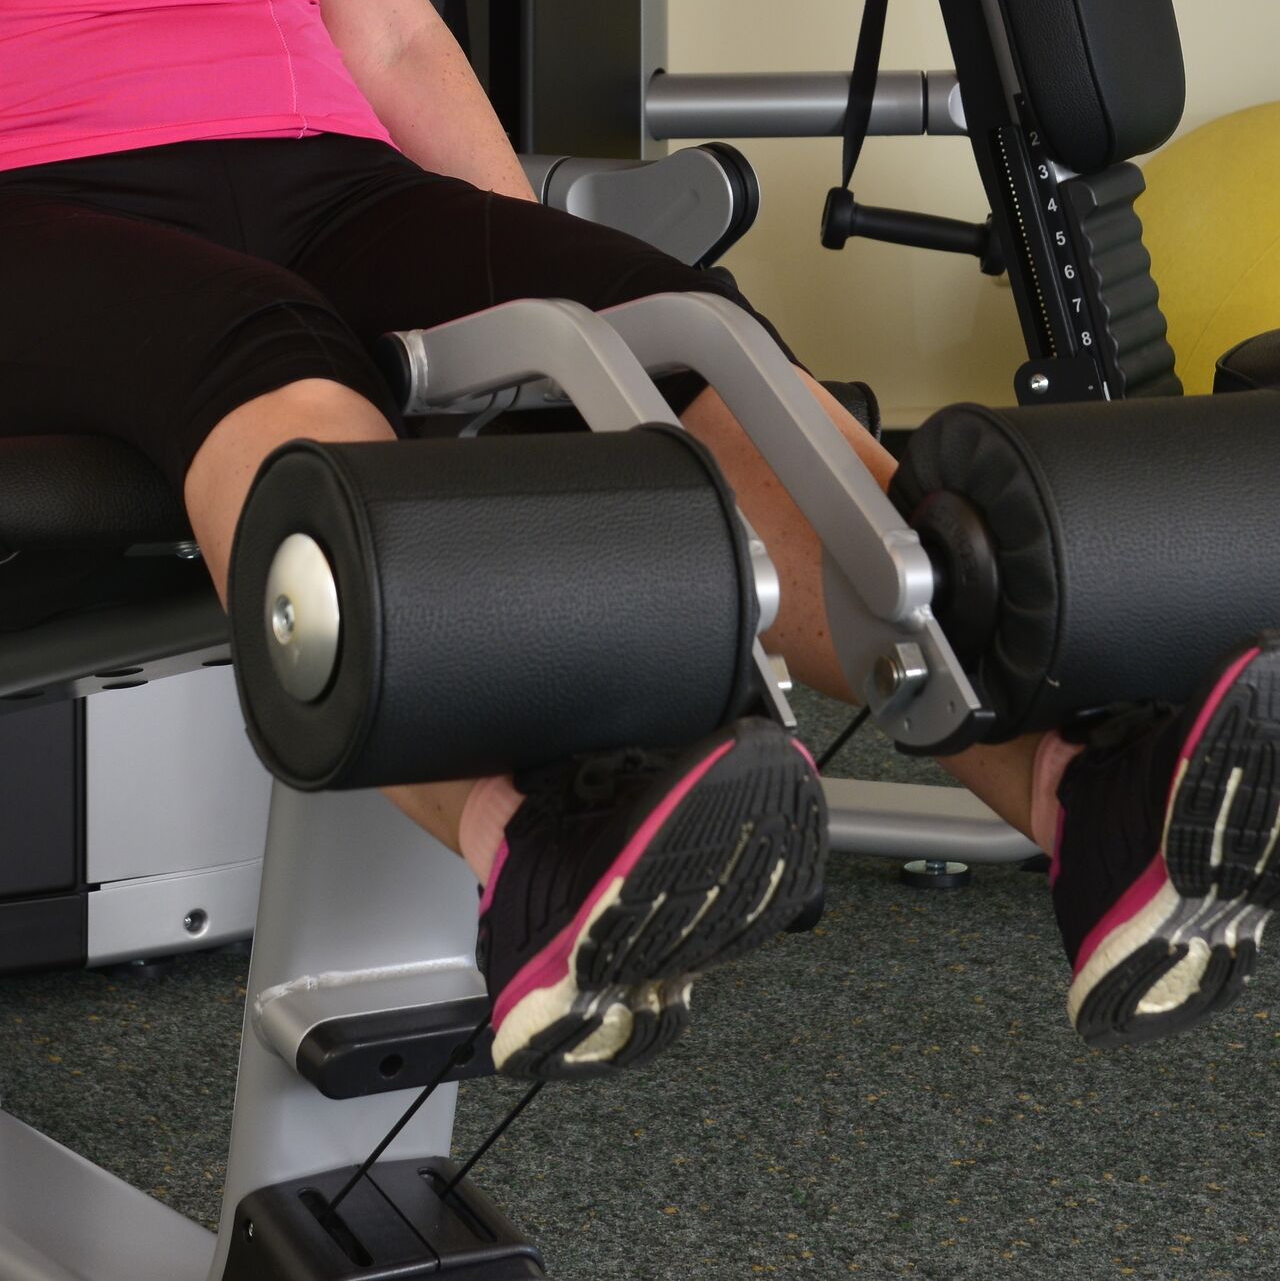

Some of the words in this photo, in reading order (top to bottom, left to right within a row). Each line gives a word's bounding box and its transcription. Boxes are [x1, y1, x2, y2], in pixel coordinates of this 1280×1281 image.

[1029, 131, 1041, 147] 2
[1038, 164, 1049, 180] 3
[1047, 197, 1058, 213] 4
[1055, 230, 1067, 246] 5
[1064, 264, 1075, 279] 6
[1072, 298, 1083, 313] 7
[1081, 331, 1092, 347] 8
